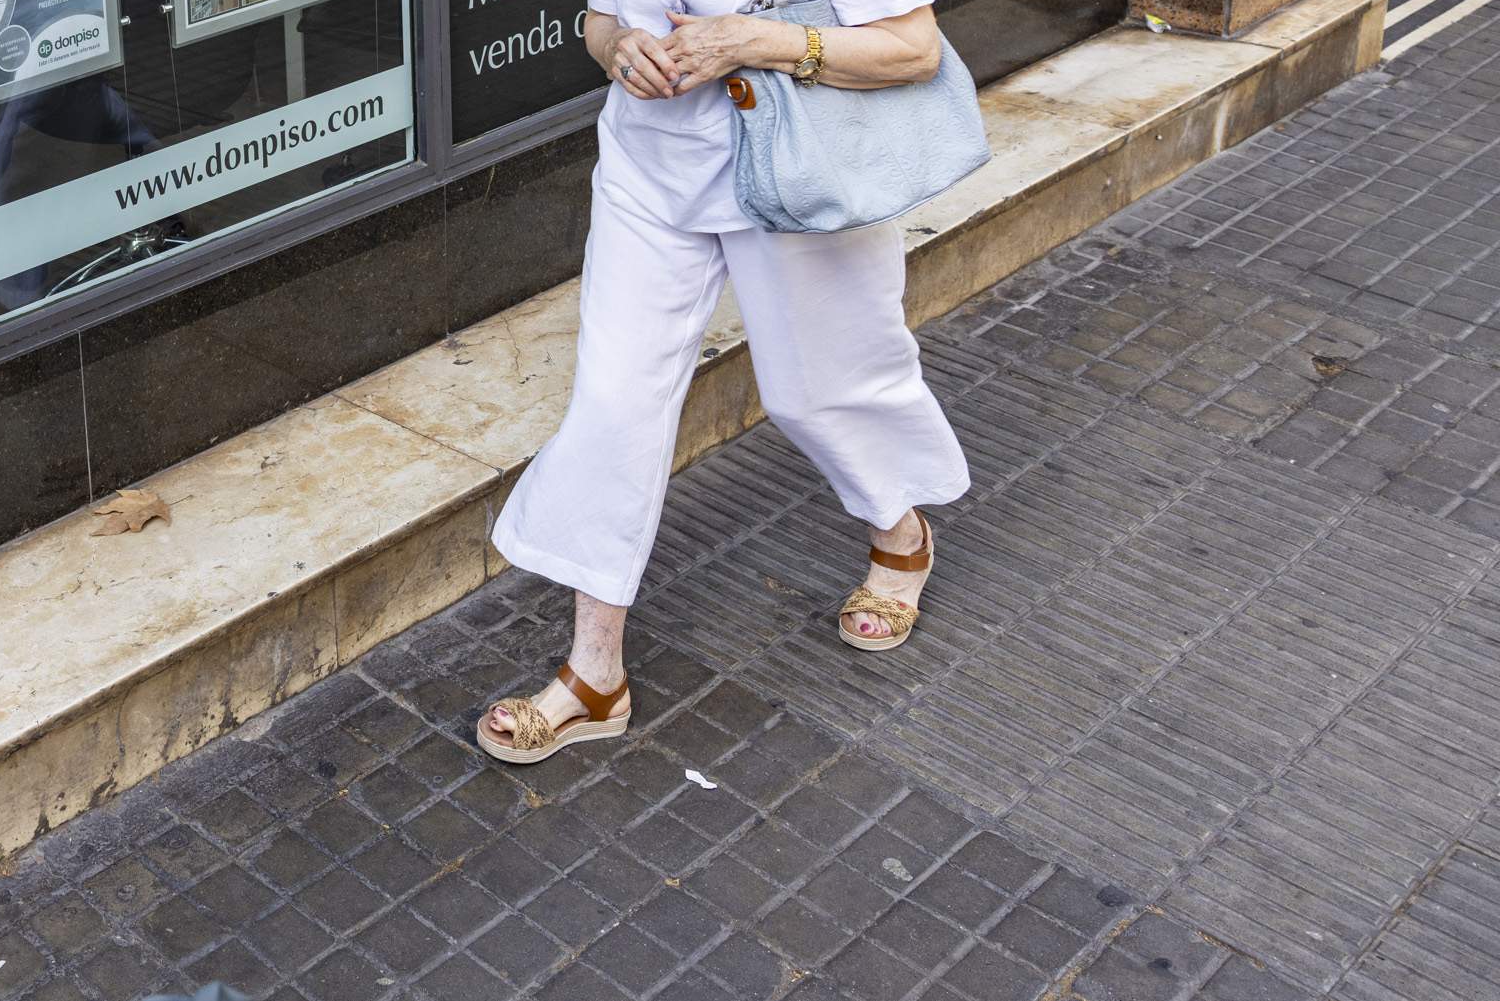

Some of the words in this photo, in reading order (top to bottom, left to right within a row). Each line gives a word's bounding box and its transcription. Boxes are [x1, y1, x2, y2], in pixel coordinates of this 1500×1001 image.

[39, 43, 51, 54] dp
[55, 27, 100, 50] donpiso
[468, 9, 564, 76] venda
[114, 94, 385, 211] www.donpiso.com
